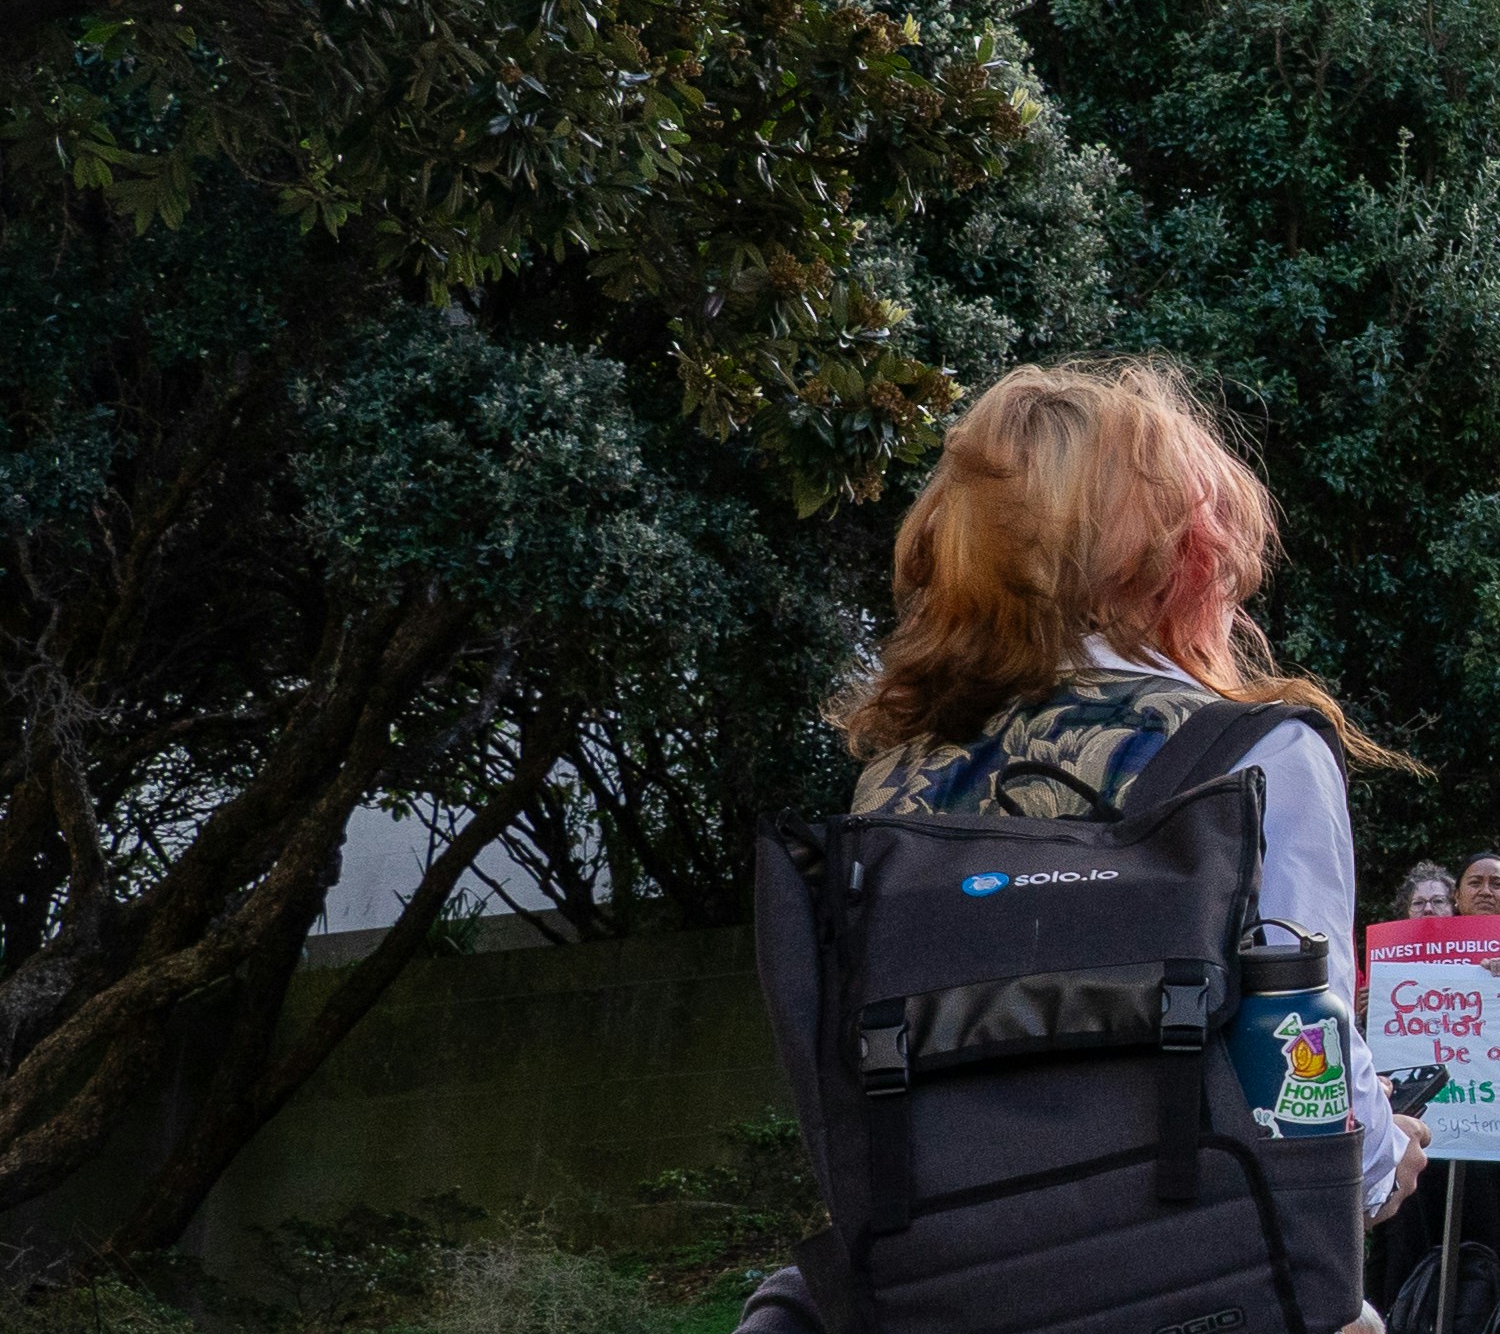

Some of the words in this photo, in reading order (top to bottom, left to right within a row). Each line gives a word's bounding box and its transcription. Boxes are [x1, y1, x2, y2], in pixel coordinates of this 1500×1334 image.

[1014, 869, 1119, 887] solo.io
[1371, 943, 1422, 960] INVEST
[1427, 941, 1442, 954] IN
[1446, 940, 1500, 954] PUBLIC
[1390, 980, 1483, 1019] Going
[1384, 1011, 1486, 1036] doctor
[1433, 1039, 1470, 1063] be
[1284, 1081, 1346, 1101] HOMES
[1279, 1101, 1318, 1118] FOR
[1322, 1101, 1348, 1117] ALL
[1438, 1116, 1500, 1138] system
